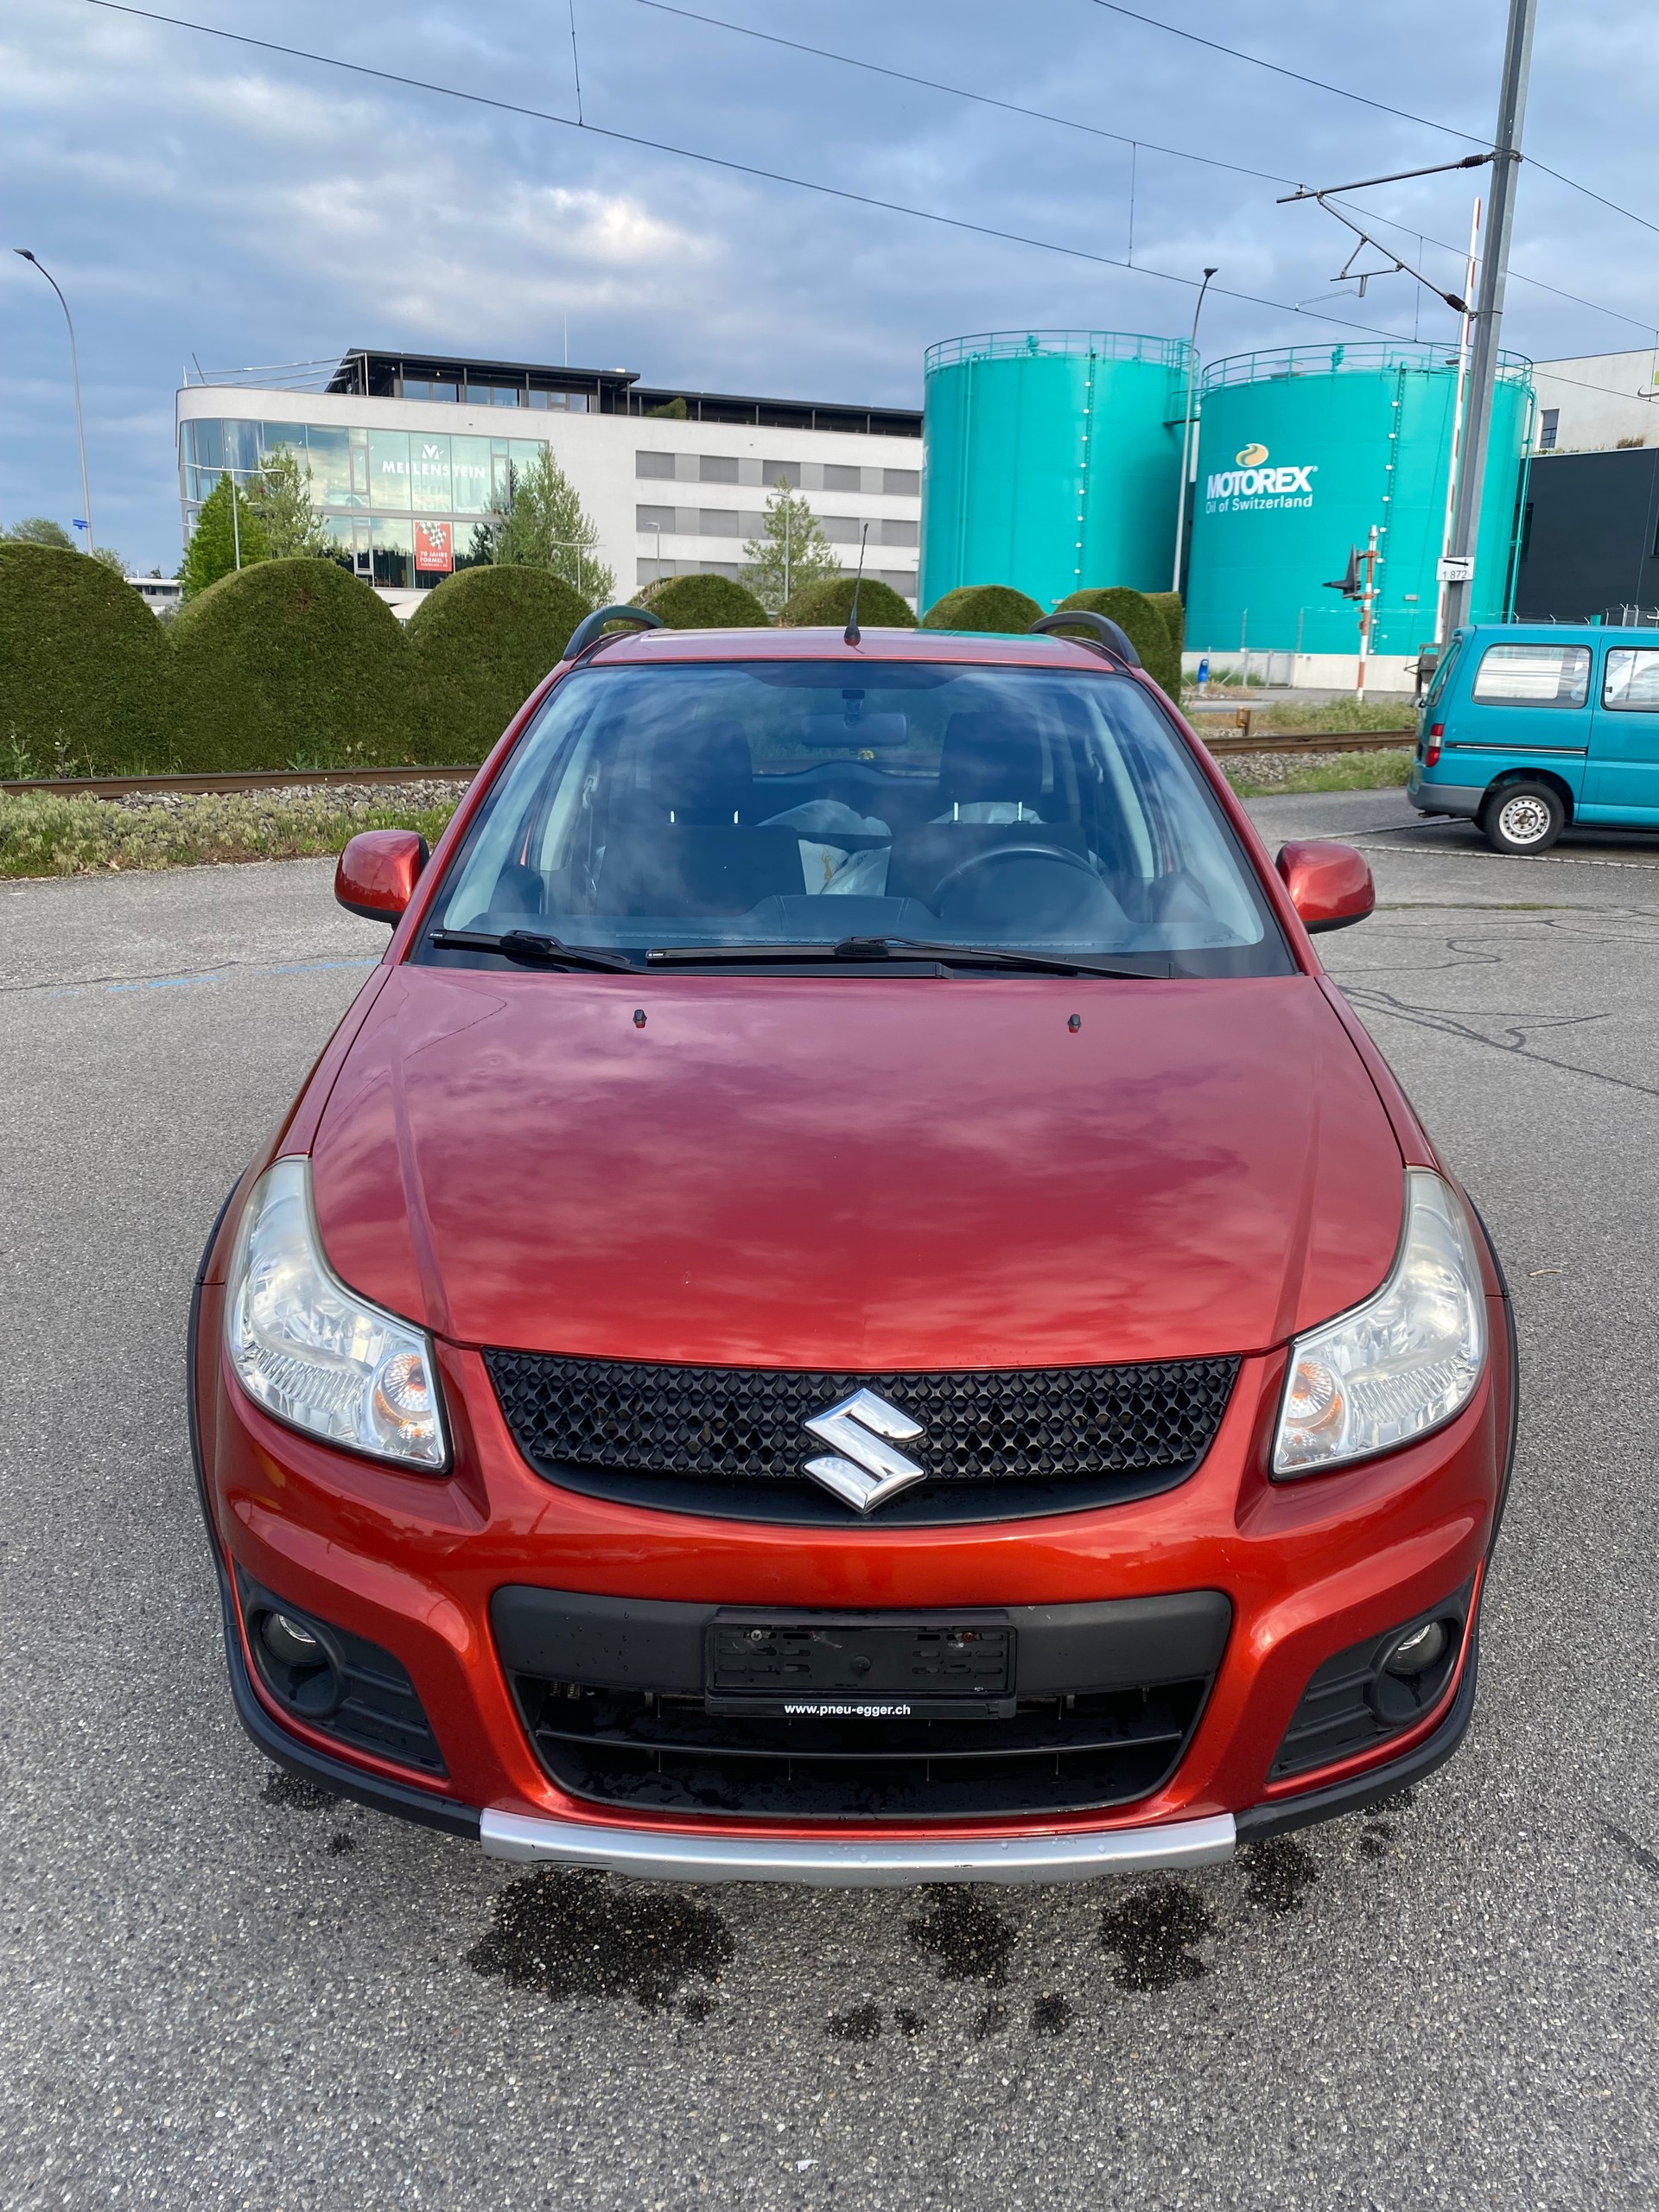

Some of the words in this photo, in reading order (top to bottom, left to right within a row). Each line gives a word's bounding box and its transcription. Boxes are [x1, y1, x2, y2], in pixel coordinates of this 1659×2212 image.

[382, 461, 485, 478] MEILENSTEIN
[1206, 466, 1313, 499] MOTOREX
[1206, 500, 1217, 514] Oil
[1218, 499, 1230, 512] of
[1232, 494, 1313, 511] Switzerland
[785, 1704, 911, 1717] www.pneu-egger.ch
